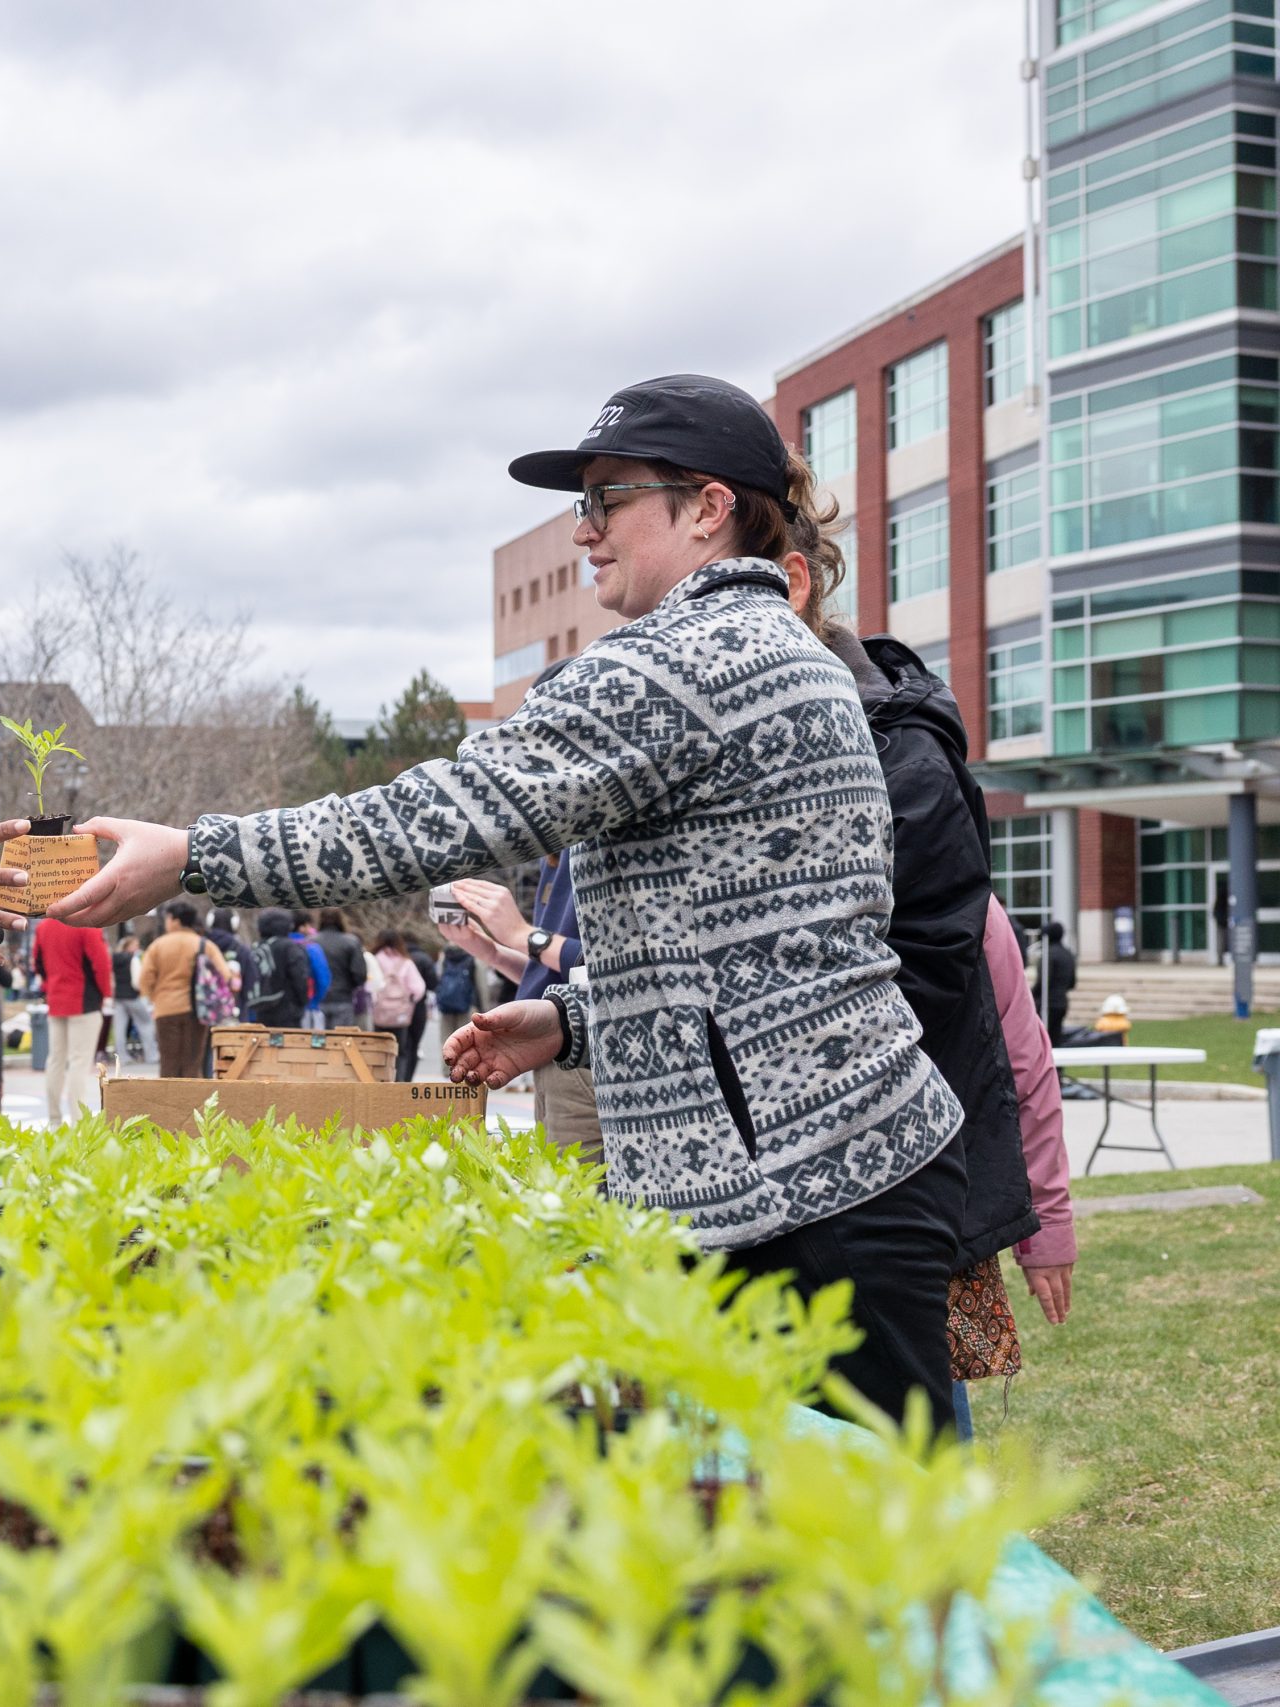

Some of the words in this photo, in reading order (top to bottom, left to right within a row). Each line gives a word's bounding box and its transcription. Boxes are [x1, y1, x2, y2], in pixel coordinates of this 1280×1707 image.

[36, 870, 60, 878] friends
[33, 881, 46, 889] you
[48, 878, 75, 886] referred
[35, 893, 51, 901] your
[411, 1087, 431, 1099] 9.6
[435, 1086, 478, 1099] LITERS
